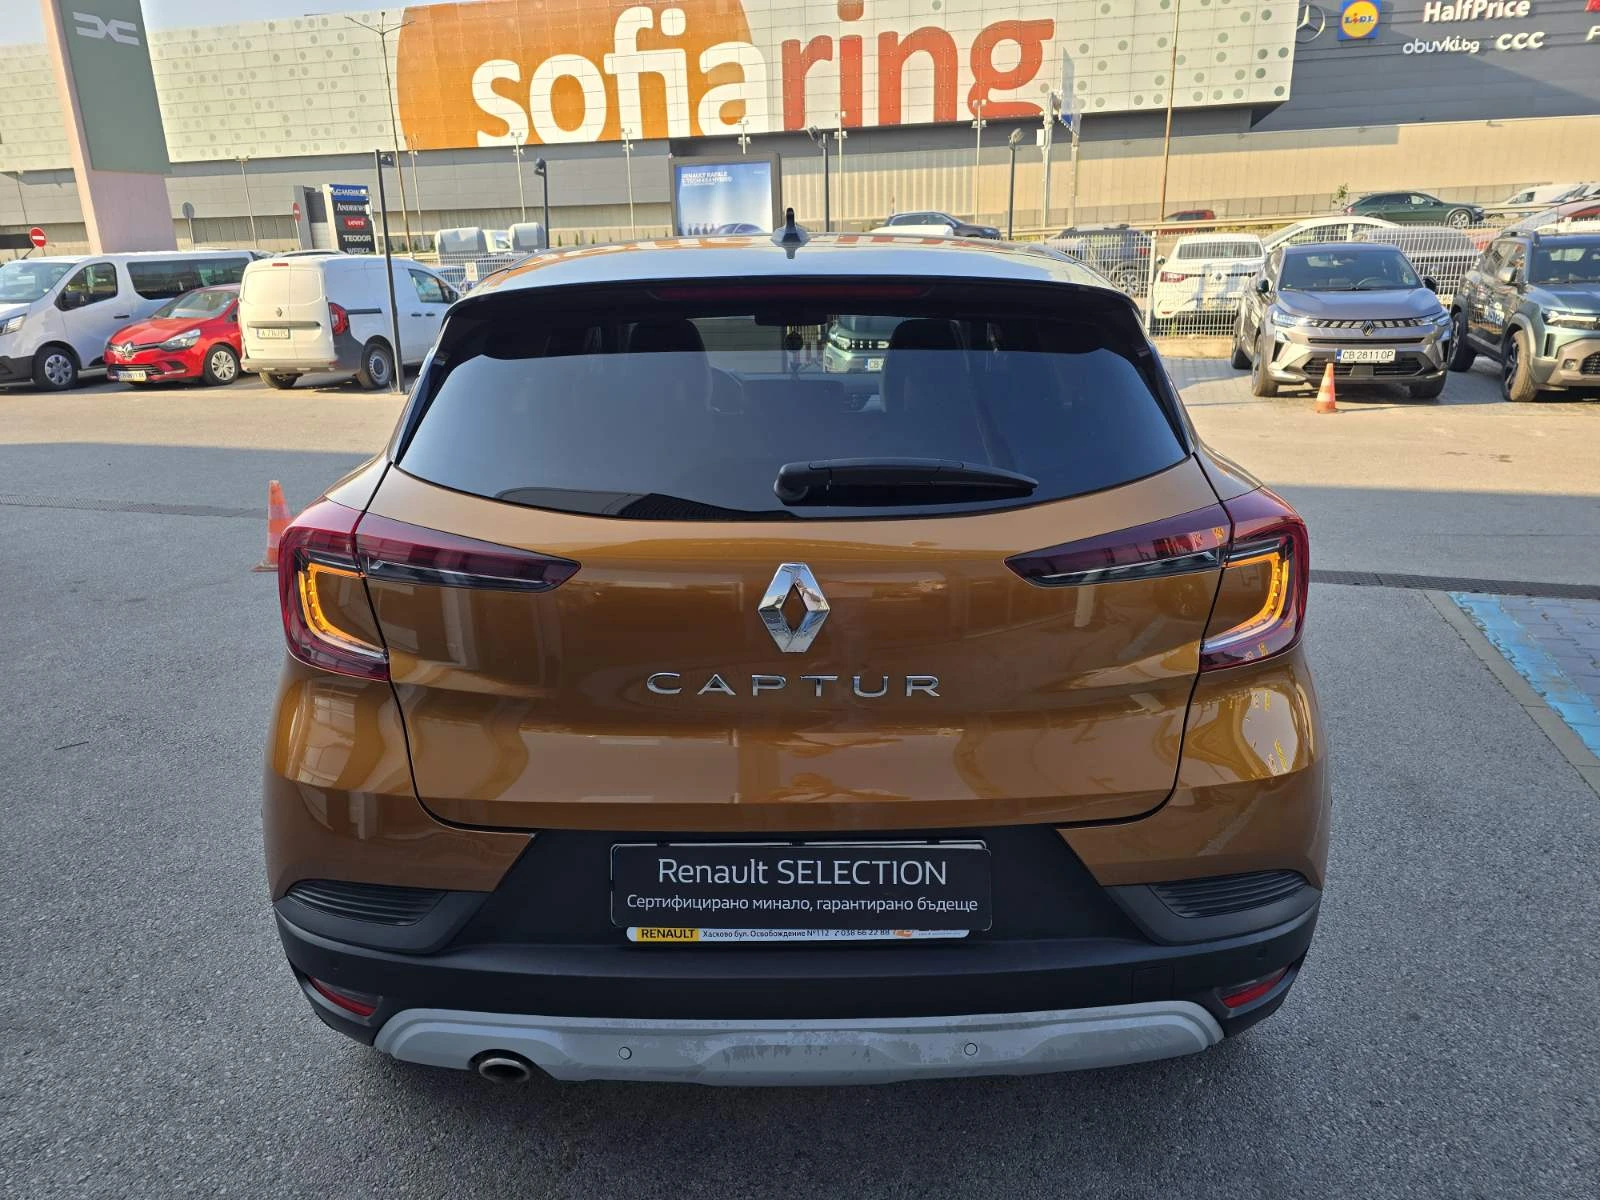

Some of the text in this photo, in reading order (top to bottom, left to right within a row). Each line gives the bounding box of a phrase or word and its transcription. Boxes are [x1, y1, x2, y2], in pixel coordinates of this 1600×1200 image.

[1423, 0, 1531, 23] HalfPrice
[1403, 35, 1480, 54] obuvki.bg
[1495, 31, 1546, 50] CCC
[343, 234, 371, 242] TEODOR
[646, 672, 941, 698] CAPTUR
[658, 858, 947, 886] Renault SELECTION
[627, 894, 979, 914] Сертифицирано минало, гарантирано бъдеще
[641, 928, 695, 938] RENAULT
[703, 930, 734, 938] Хасково
[750, 929, 806, 940] Освобождение
